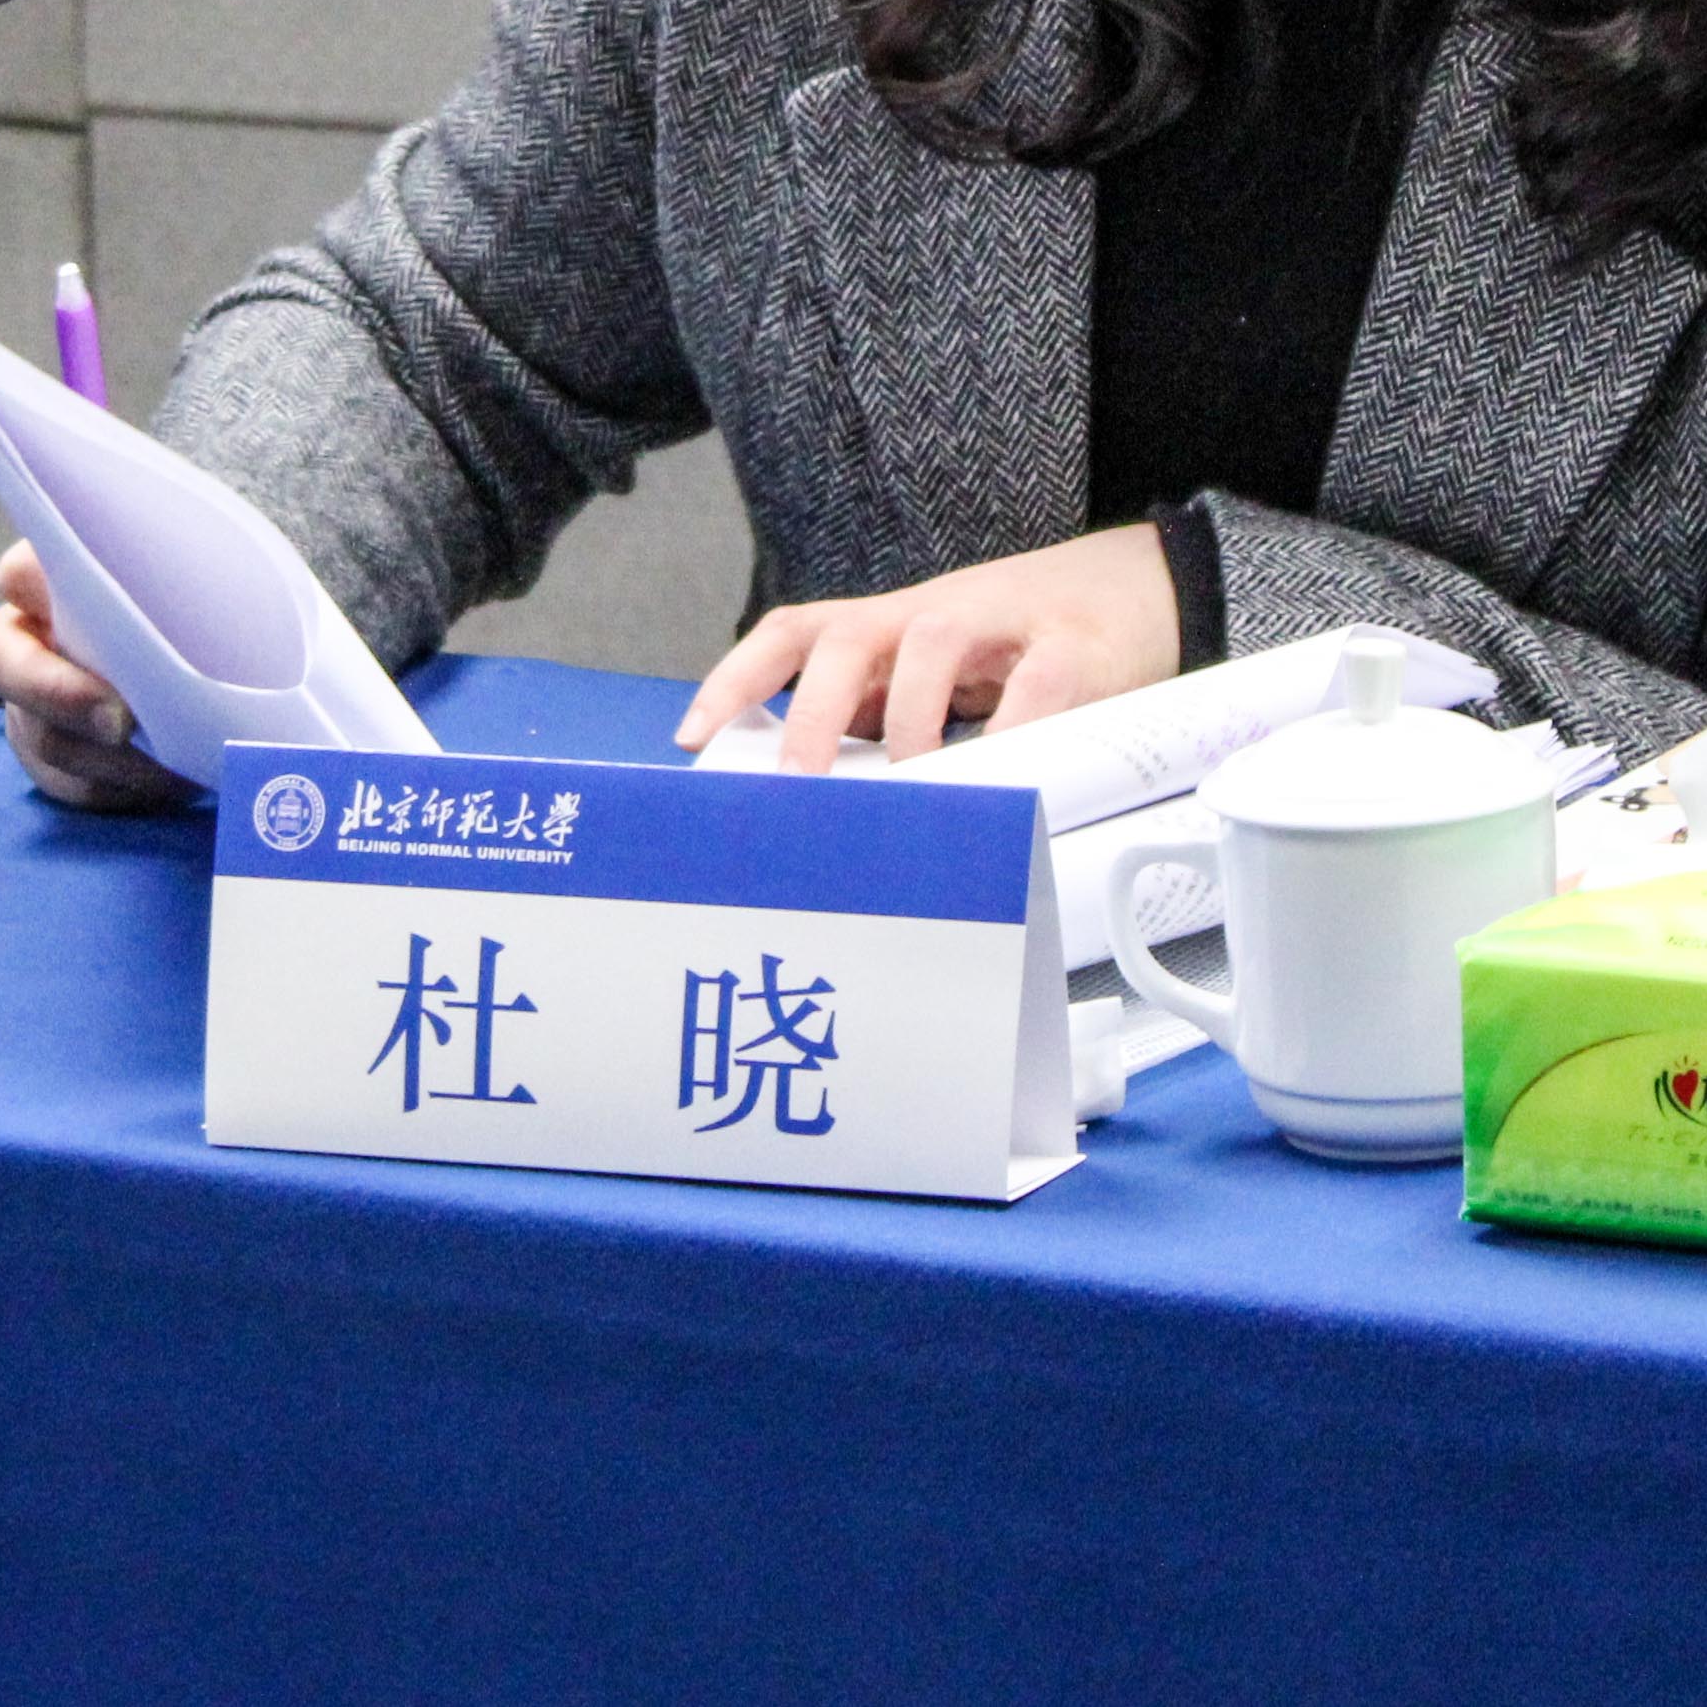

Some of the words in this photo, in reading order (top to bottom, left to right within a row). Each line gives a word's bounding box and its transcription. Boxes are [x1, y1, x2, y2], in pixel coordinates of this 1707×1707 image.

[337, 838, 402, 856] BEIJING
[405, 842, 472, 860] NORMAL
[476, 846, 573, 865] UNIVERSITY
